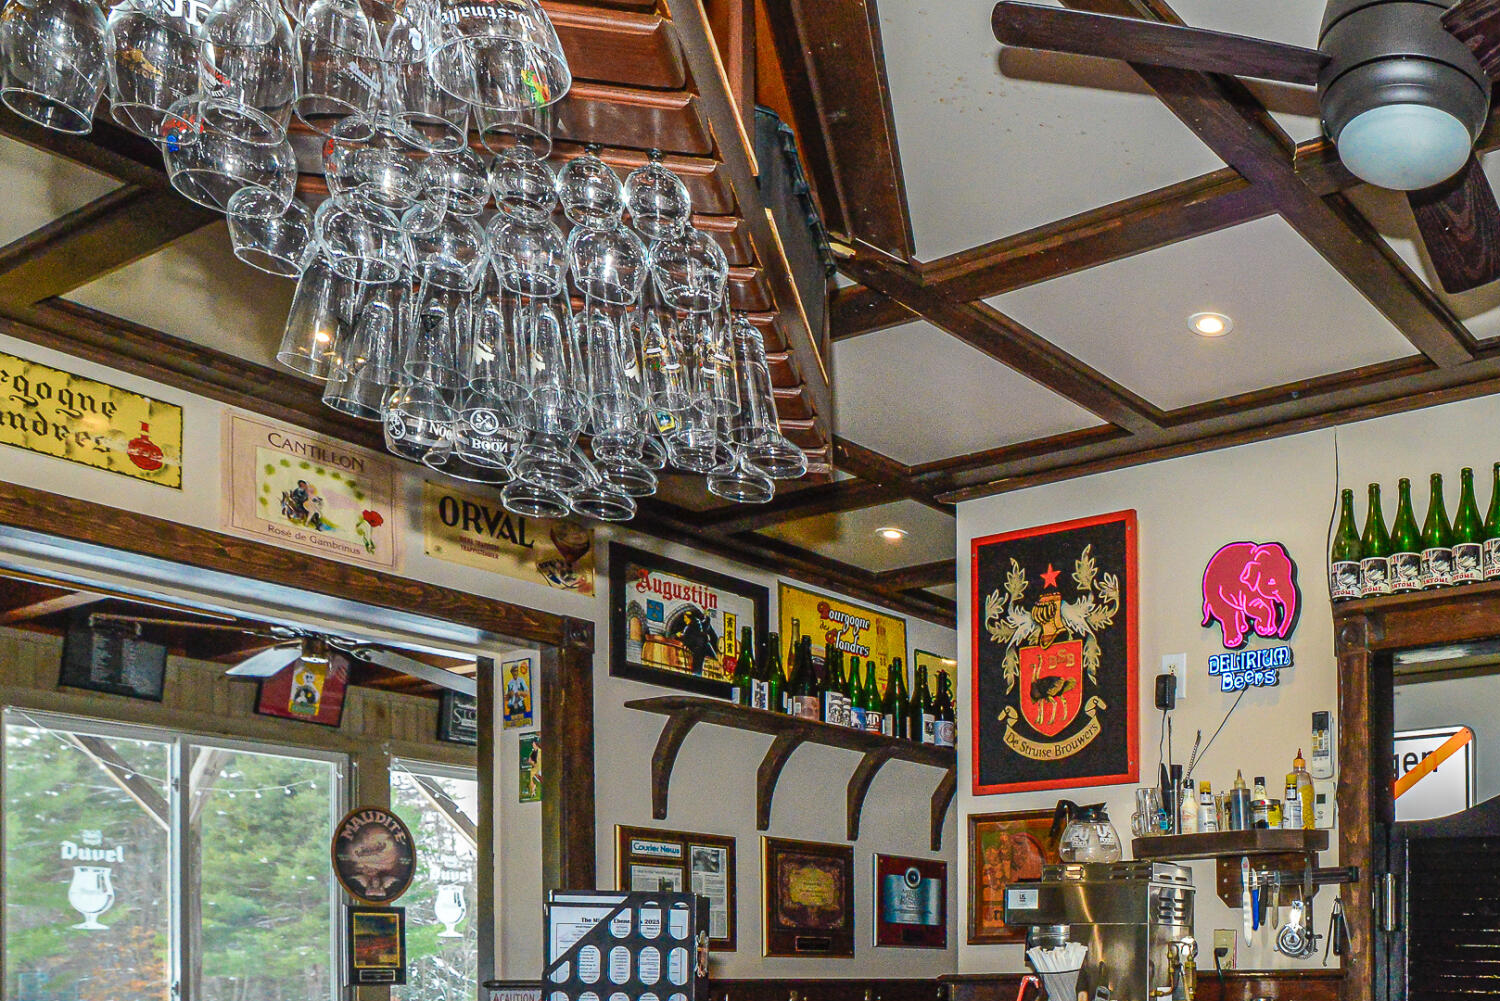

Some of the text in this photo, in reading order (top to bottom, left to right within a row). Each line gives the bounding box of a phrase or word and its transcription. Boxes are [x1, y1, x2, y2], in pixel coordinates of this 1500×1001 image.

[441, 5, 536, 32] Westmalle
[0, 411, 111, 453] ndres
[267, 432, 365, 472] CANTILLON
[439, 495, 535, 549] ORVAL
[267, 524, 361, 555] Rosé de Gambrinus
[636, 569, 718, 610] Augustijn
[817, 601, 871, 632] Bourgogne
[1208, 646, 1290, 674] DELIRIUM
[1220, 669, 1280, 692] Beers
[1006, 723, 1099, 759] De Struise Brouwers
[340, 811, 407, 845] MAUDITE
[61, 839, 125, 864] Duvel
